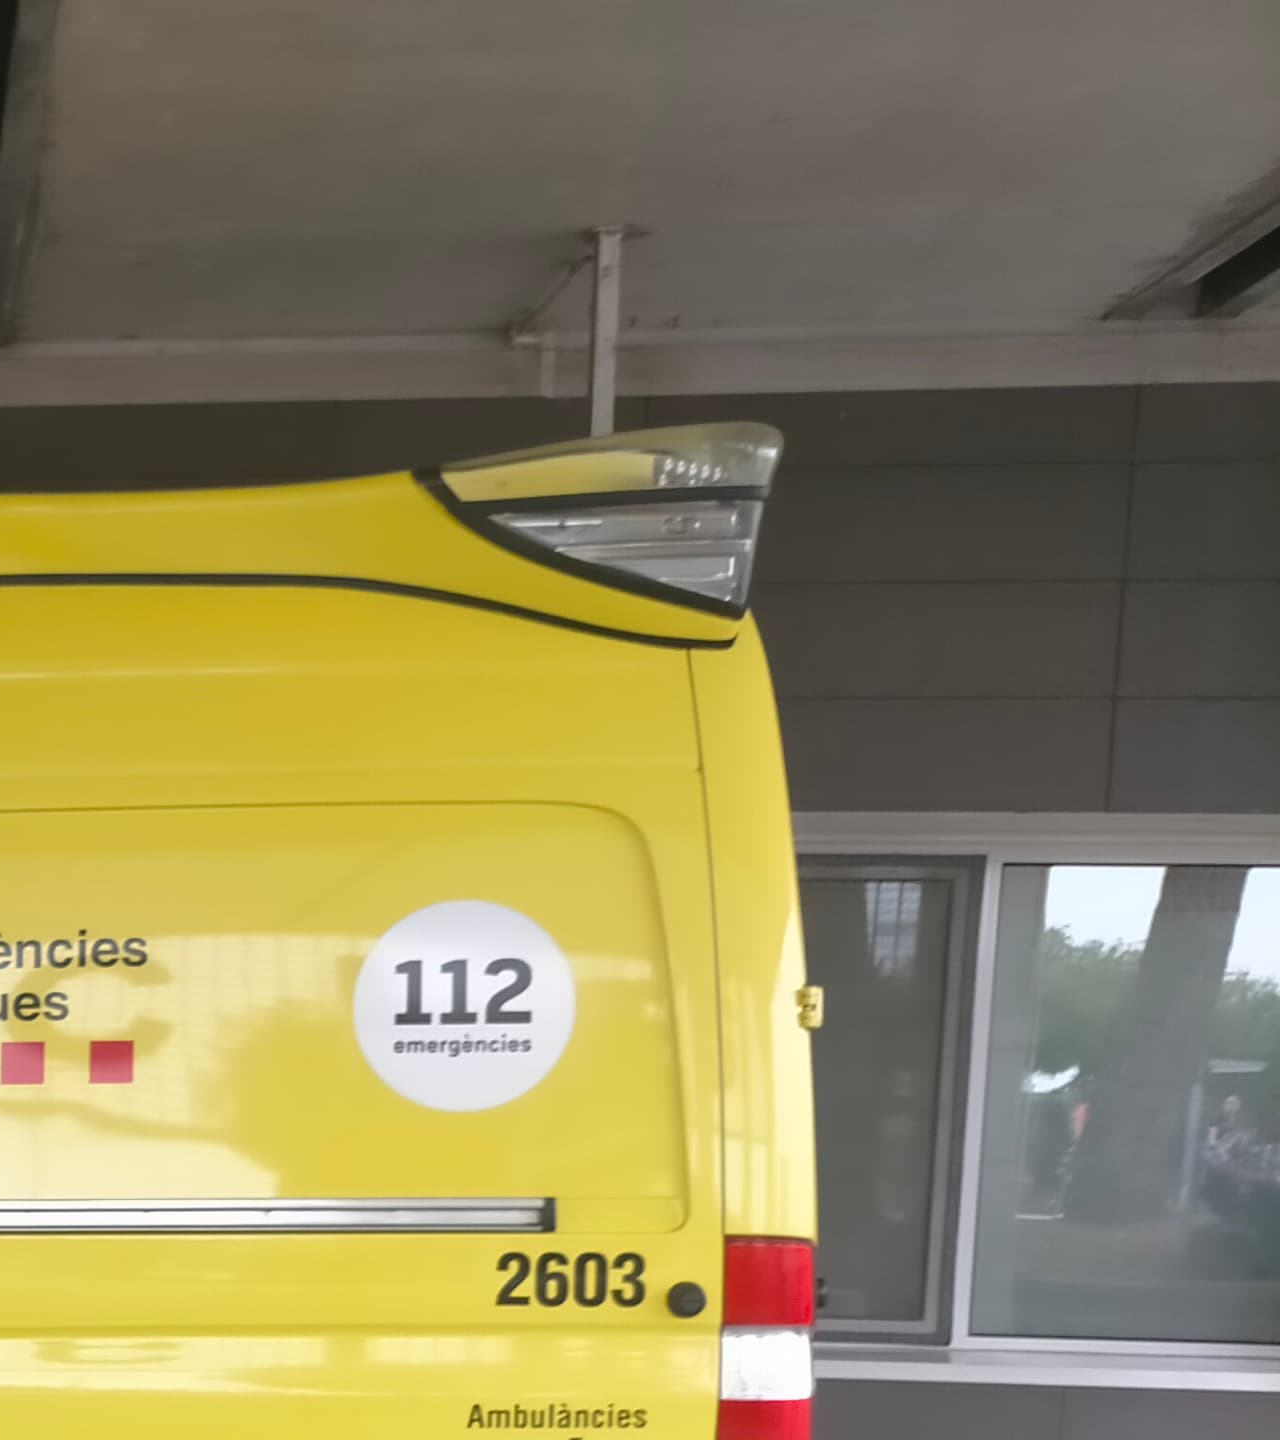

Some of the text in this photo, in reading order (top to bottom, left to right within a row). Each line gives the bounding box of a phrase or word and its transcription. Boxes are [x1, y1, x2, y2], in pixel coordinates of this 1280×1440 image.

[393, 957, 533, 1025] 112
[393, 1034, 532, 1057] emergències
[495, 1252, 646, 1307] 2603
[466, 1403, 648, 1429] Ambulàncies
